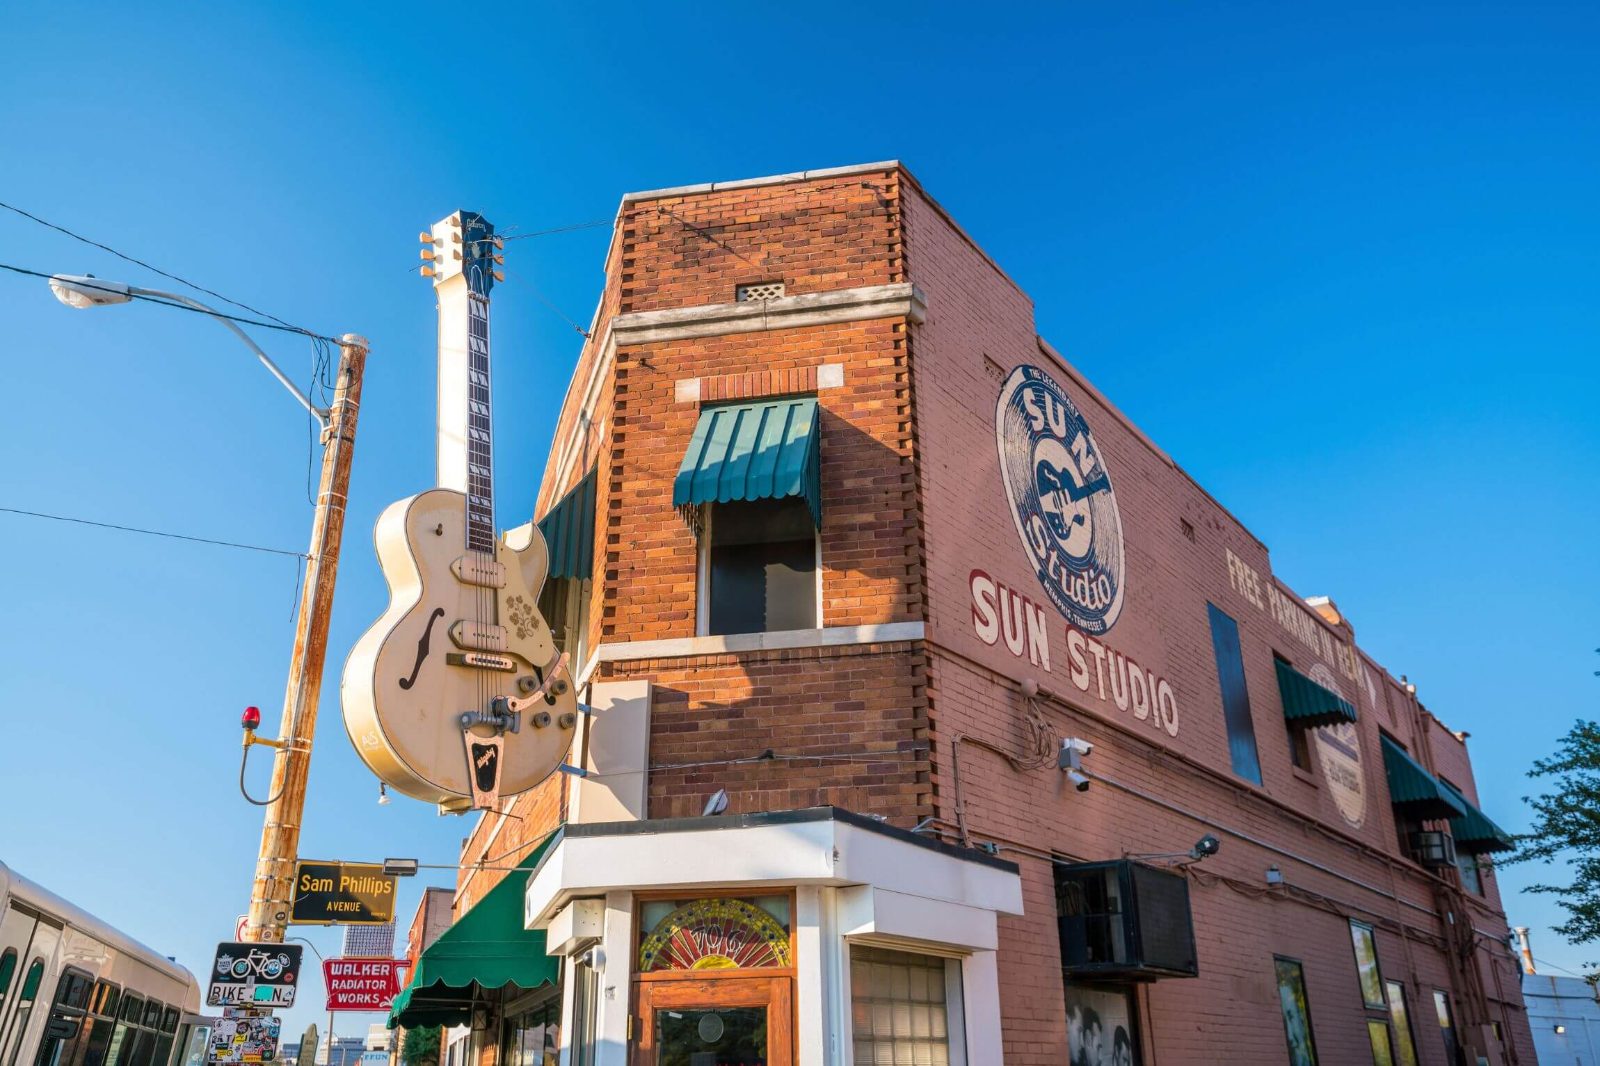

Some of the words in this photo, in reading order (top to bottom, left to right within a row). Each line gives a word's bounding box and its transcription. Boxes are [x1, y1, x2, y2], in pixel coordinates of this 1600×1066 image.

[1029, 369, 1041, 380] THE
[1042, 373, 1079, 416] LEGENDARY
[1023, 387, 1096, 477] SUN
[1226, 548, 1264, 611] FREE
[1267, 582, 1321, 656] PARKING
[969, 568, 1051, 673] SUN
[1065, 624, 1179, 738] STUDIO
[300, 874, 333, 892] Sam
[339, 875, 393, 897] Phillips
[326, 901, 361, 912] AVENUE
[691, 924, 742, 953] 706
[331, 963, 390, 976] WALKER
[212, 986, 246, 1001] BIKE
[331, 979, 387, 990] RADIATOR
[338, 993, 380, 1004] WORKS
